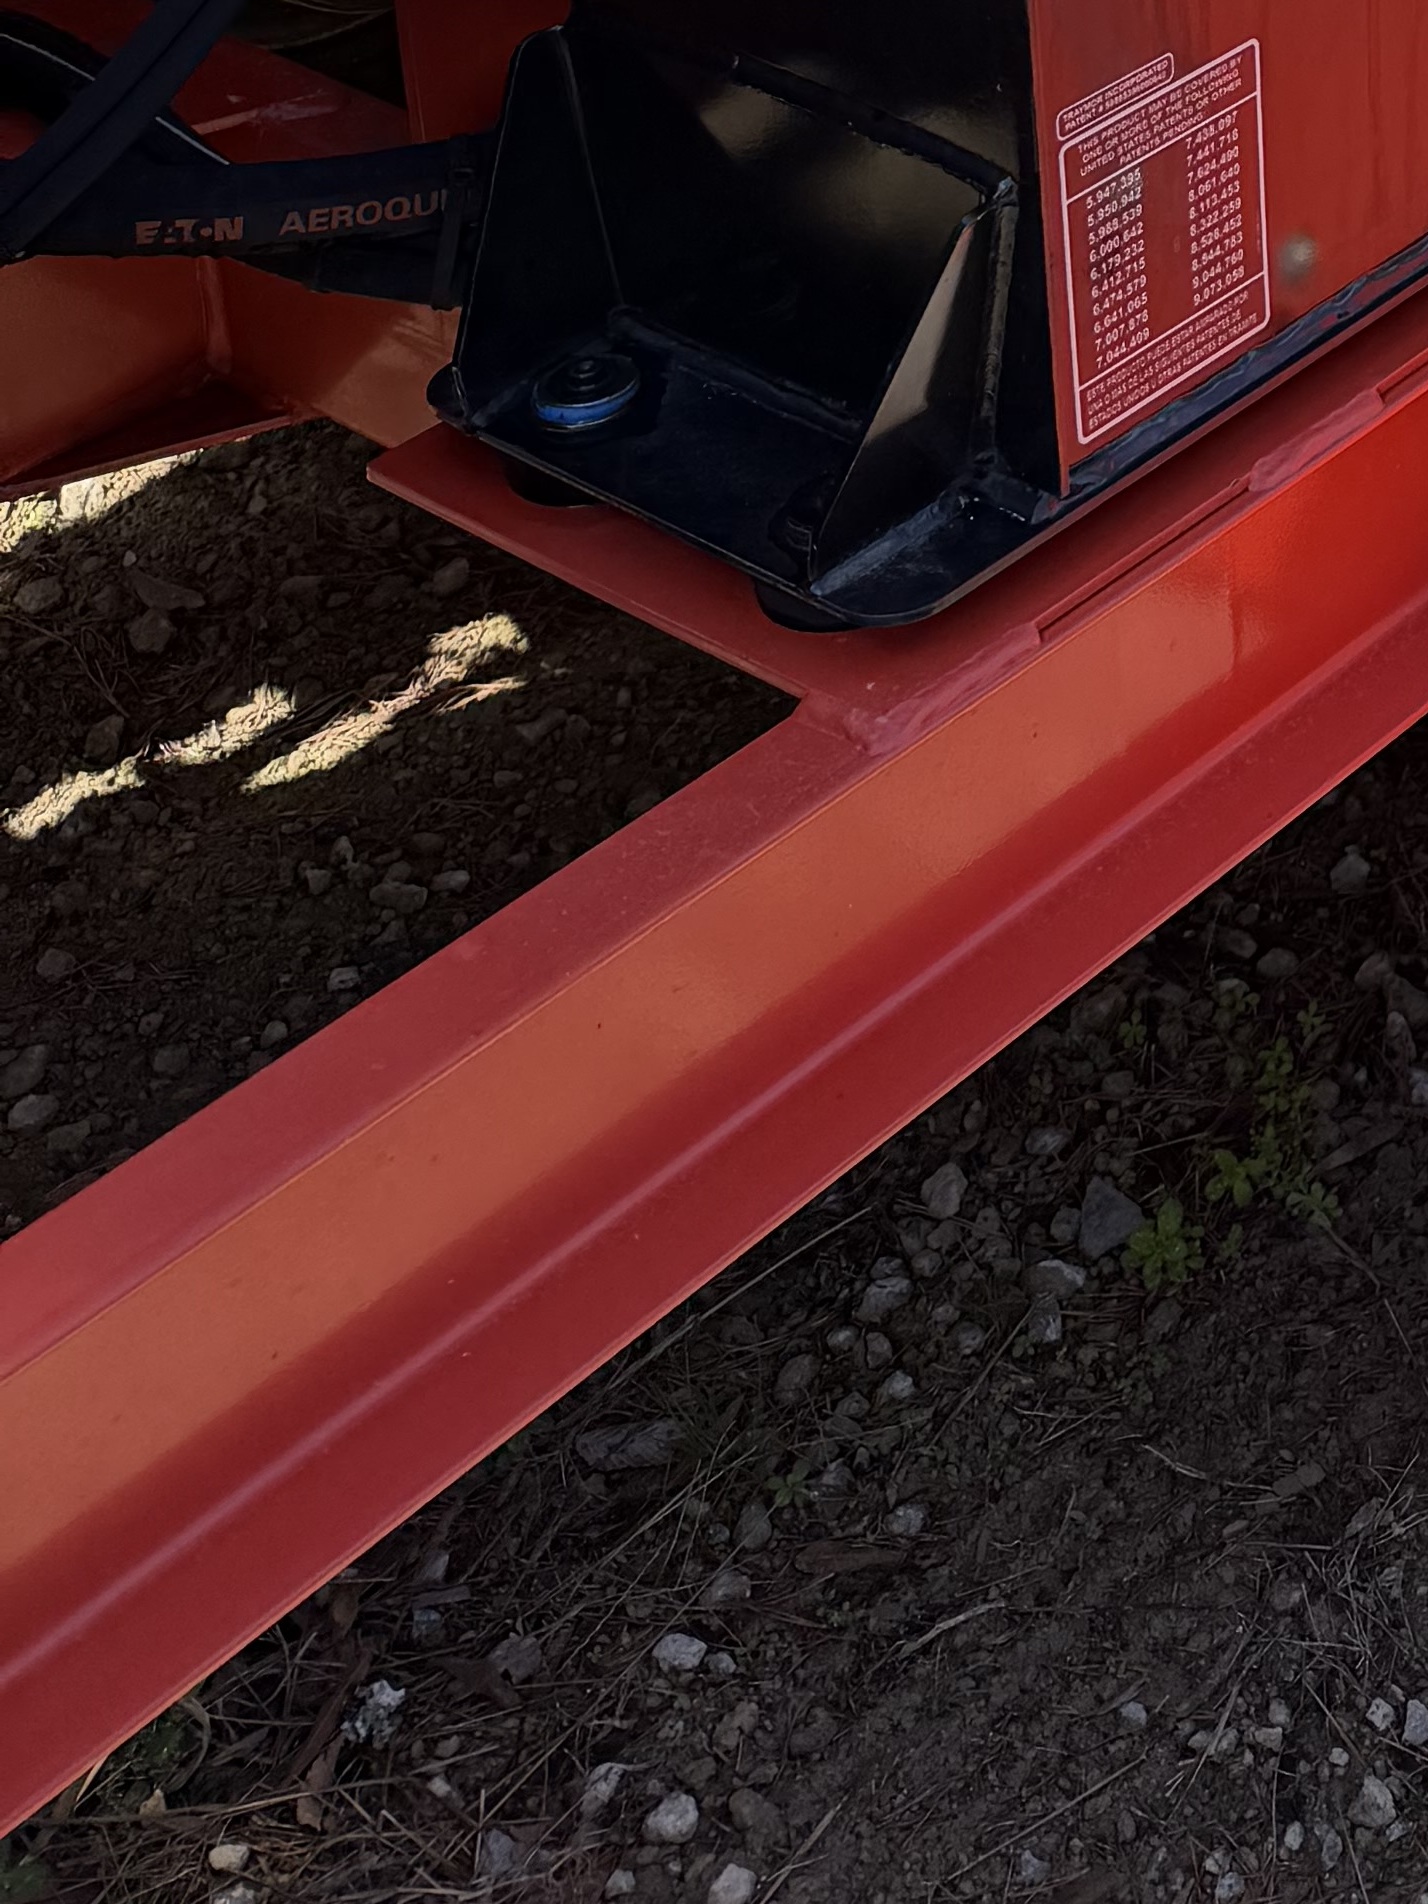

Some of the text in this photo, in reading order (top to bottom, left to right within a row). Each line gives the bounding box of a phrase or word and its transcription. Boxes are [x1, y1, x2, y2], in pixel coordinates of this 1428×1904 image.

[1078, 135, 1099, 154] THIS
[1102, 112, 1146, 140] PRODUCT
[1149, 98, 1168, 116] MAY
[1185, 66, 1227, 94] COVERED
[1230, 56, 1242, 70] BY
[1105, 60, 1168, 100] INCORPORATED
[1065, 110, 1096, 132] PATENT
[1080, 78, 1242, 176] UNITED STATES PATENTS OR OTHER
[1082, 70, 1239, 162] ONE OR MORE OF THE FOLLOWING
[1120, 138, 1160, 166] PATENTS
